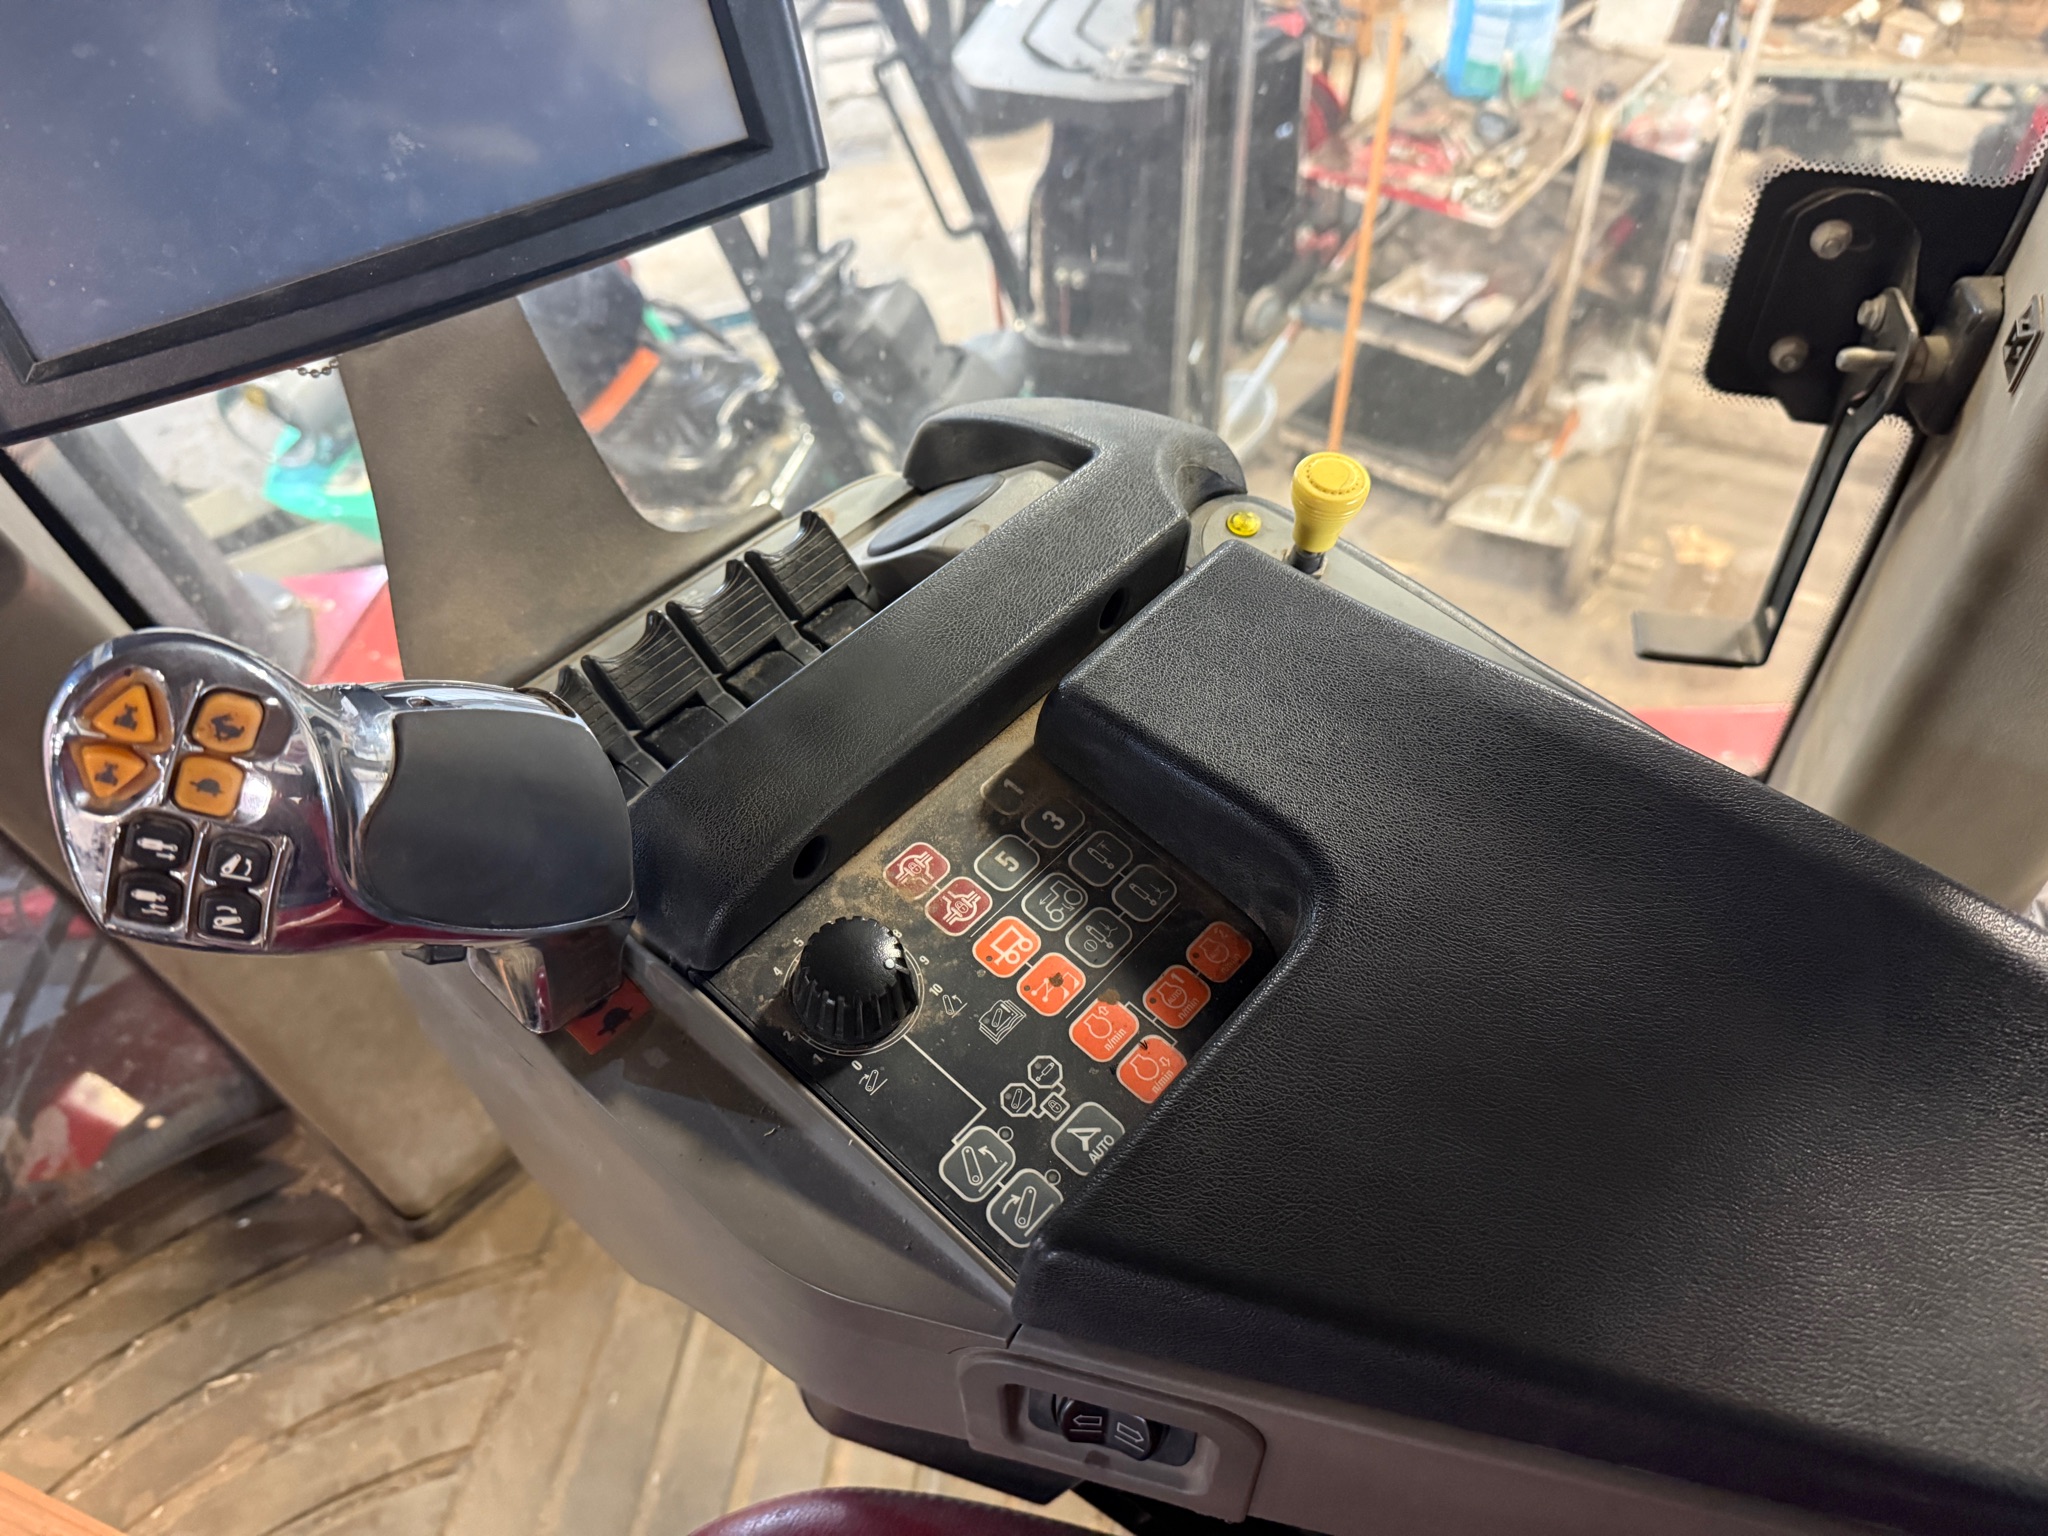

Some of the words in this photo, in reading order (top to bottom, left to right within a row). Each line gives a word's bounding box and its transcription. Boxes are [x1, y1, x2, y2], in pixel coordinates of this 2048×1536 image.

[1003, 779, 1024, 795] 1
[1042, 810, 1065, 831] 3
[994, 850, 1019, 872] 5
[793, 936, 804, 947] 5
[892, 928, 903, 939] 8
[919, 955, 930, 966] 9
[772, 966, 783, 977] 4
[1170, 972, 1185, 984] 1
[929, 983, 943, 997] 10
[1167, 987, 1183, 1005] AUTO
[1178, 997, 1200, 1021] n/min
[782, 1030, 795, 1042] 2
[1104, 1027, 1127, 1051] n/min
[1151, 1069, 1174, 1094] n/min
[1088, 1135, 1115, 1165] AUTO
